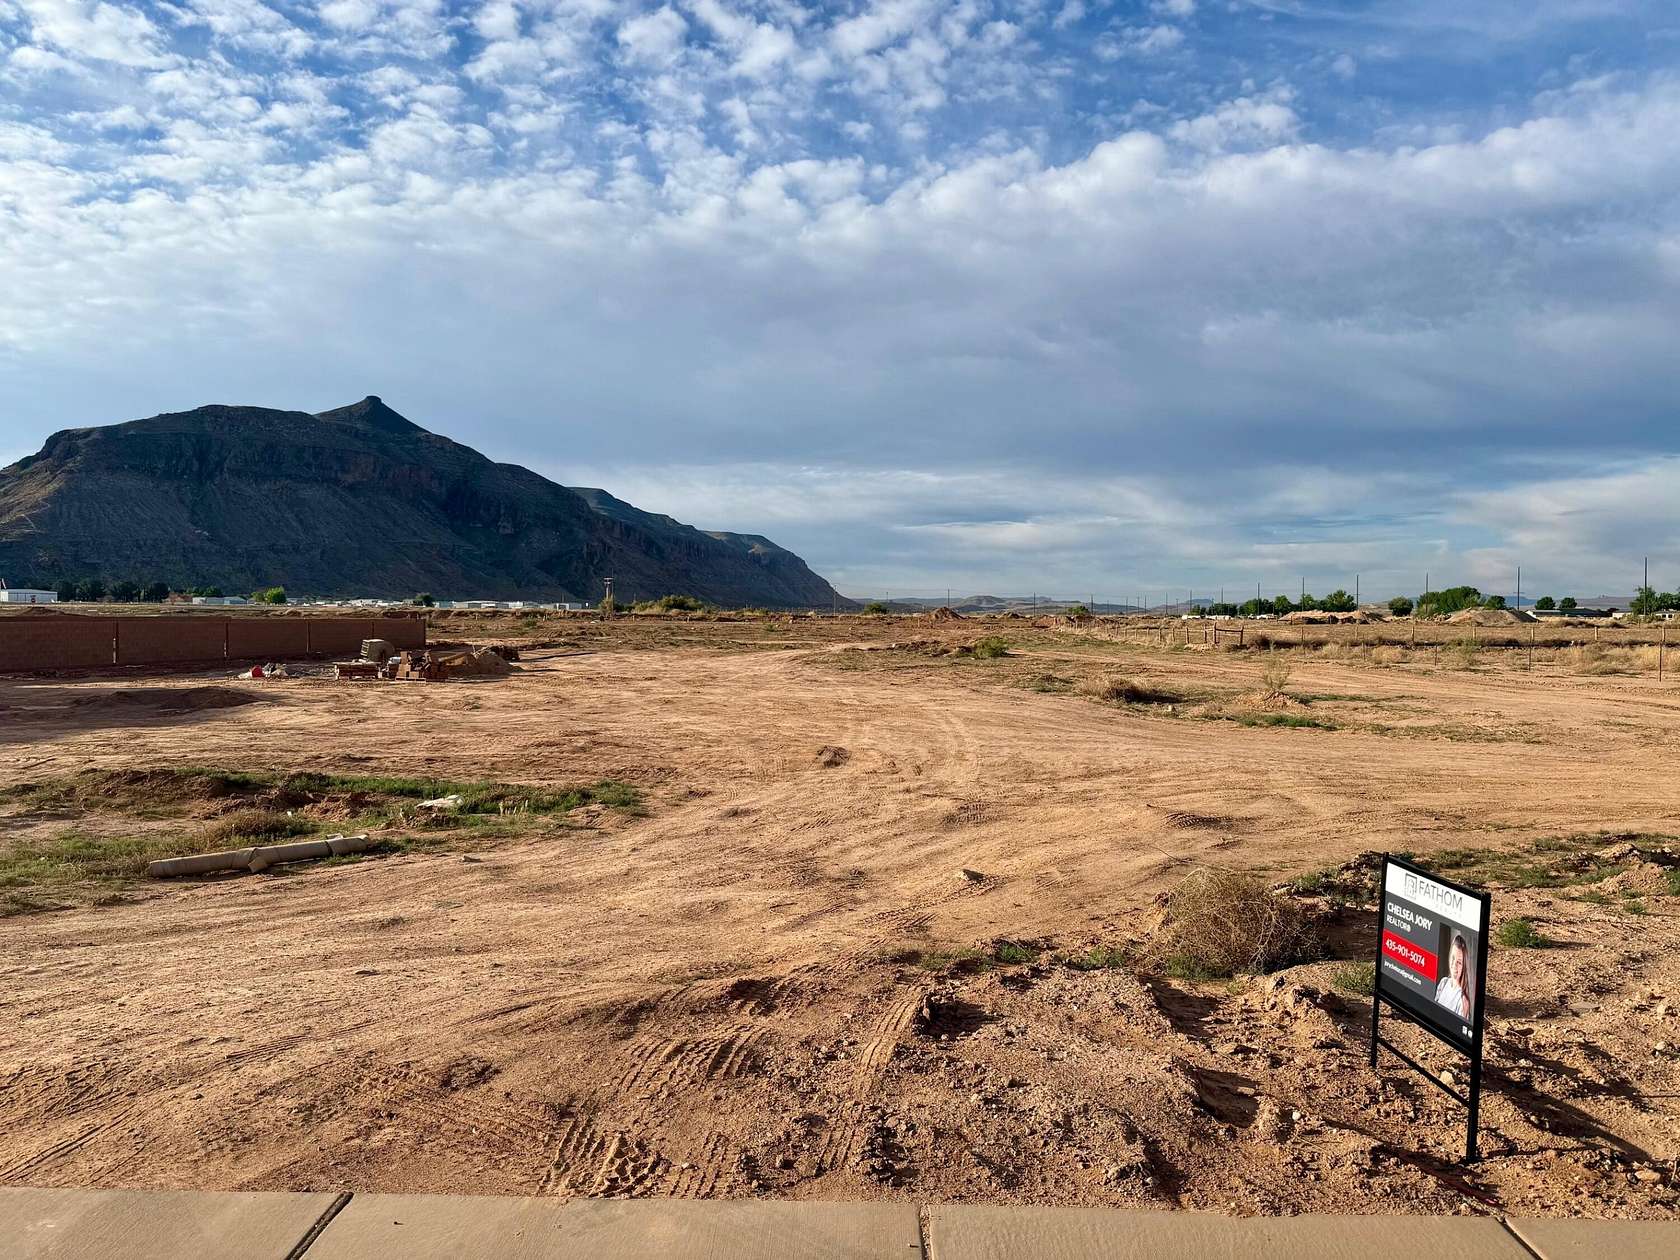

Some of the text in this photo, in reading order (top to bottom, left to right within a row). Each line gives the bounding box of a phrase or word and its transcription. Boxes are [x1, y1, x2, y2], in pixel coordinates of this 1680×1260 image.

[1419, 880, 1463, 912] FATHOM
[1387, 902, 1414, 923] CHELSEA
[1414, 914, 1433, 931] JORY
[1385, 938, 1425, 967] 435-901-5074
